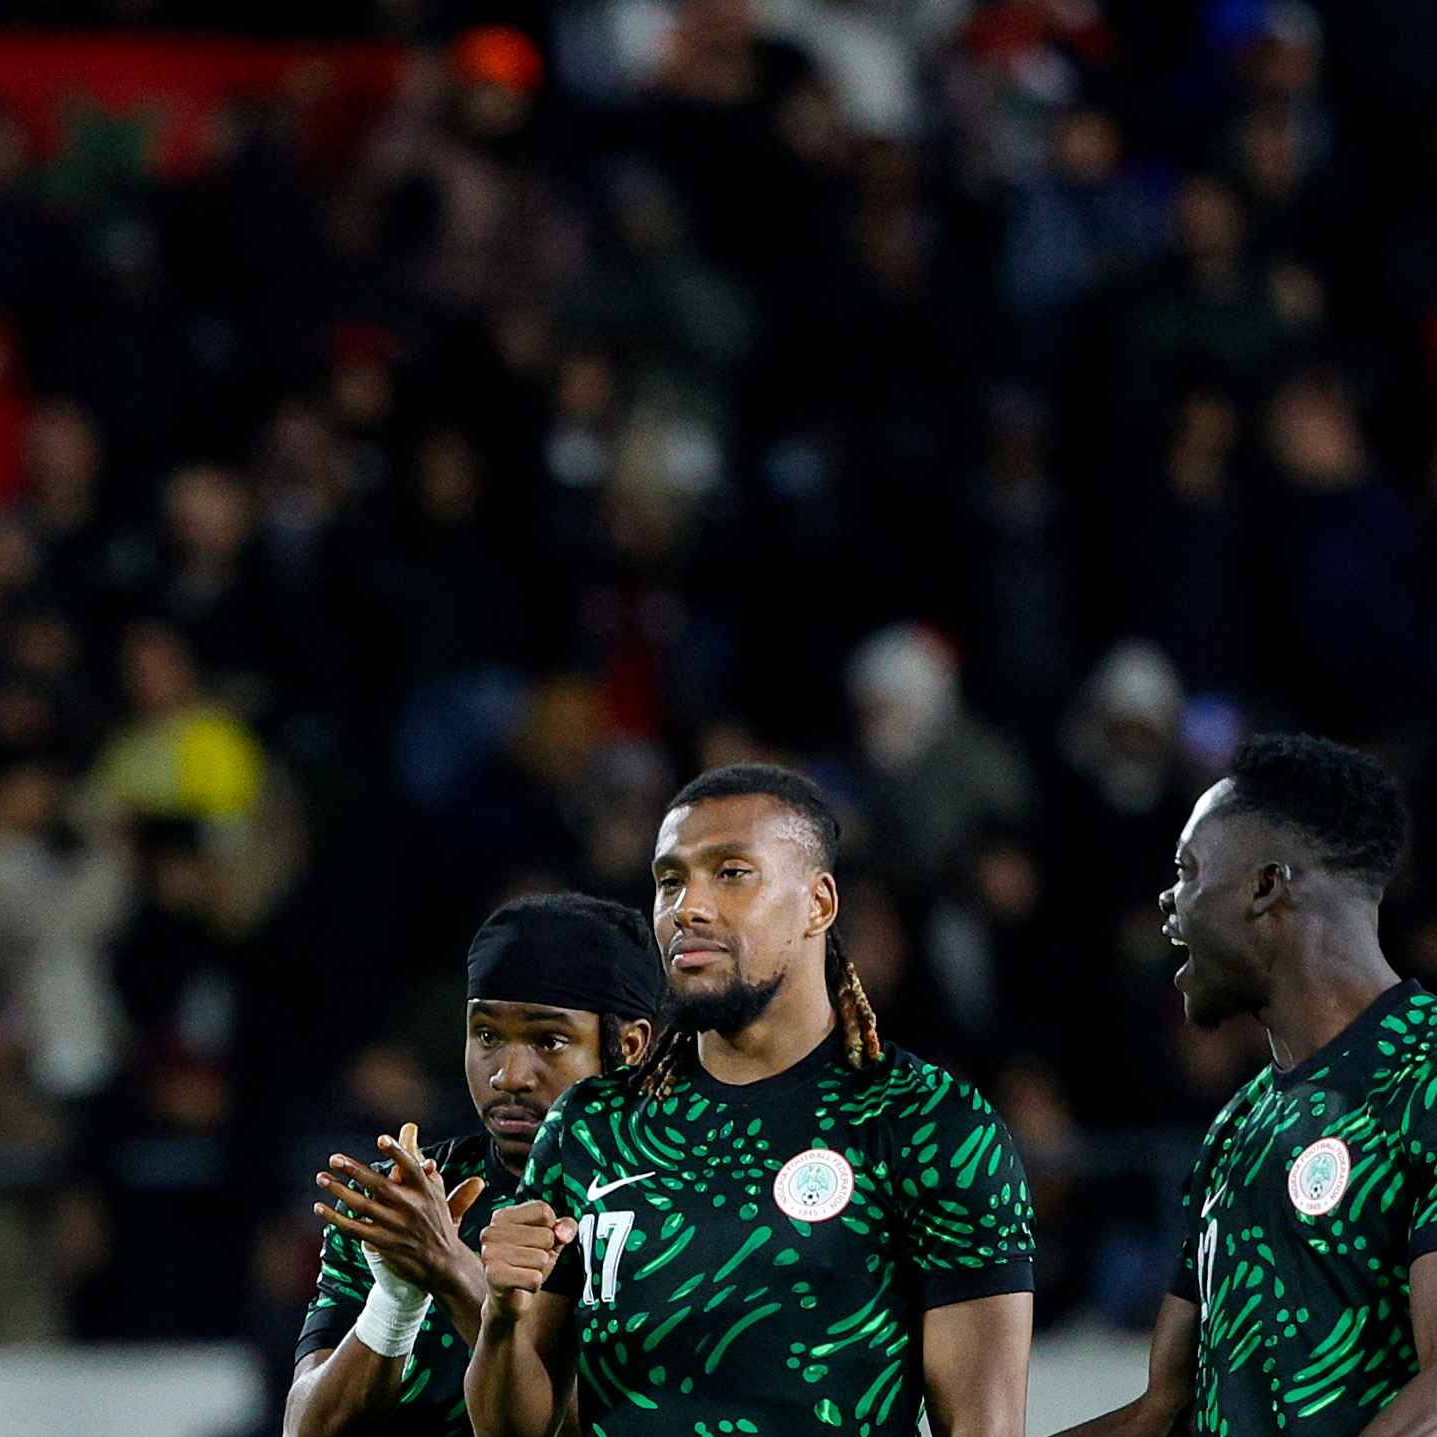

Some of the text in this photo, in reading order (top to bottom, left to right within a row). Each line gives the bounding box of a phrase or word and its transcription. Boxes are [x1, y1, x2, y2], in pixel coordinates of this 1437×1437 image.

[829, 1157, 849, 1209] FEDERATION
[798, 1208, 819, 1217] 1945
[579, 1211, 635, 1305] 17
